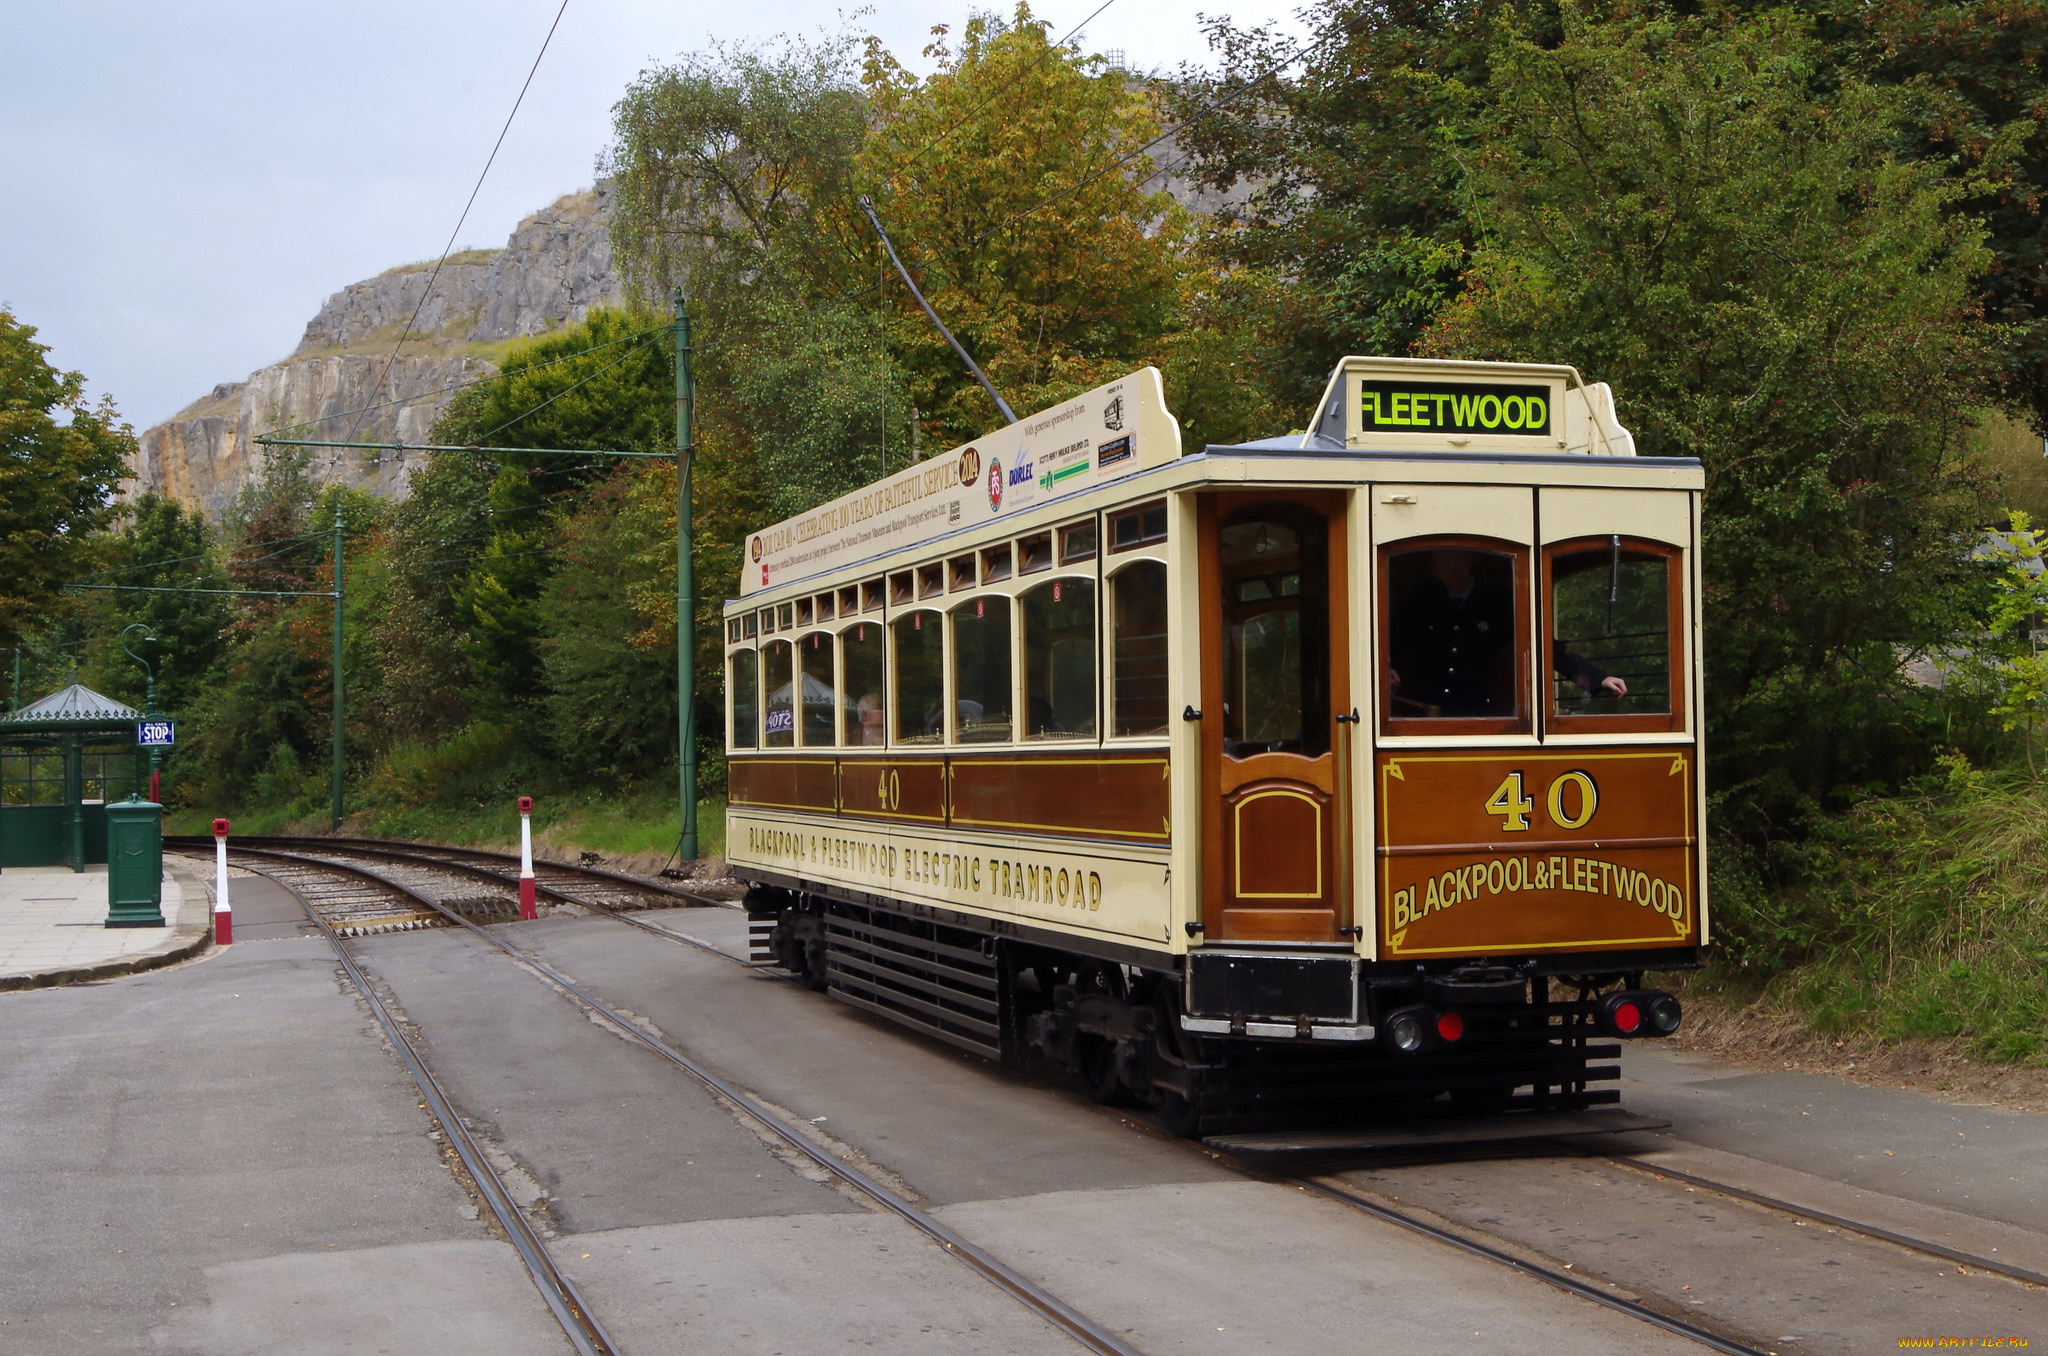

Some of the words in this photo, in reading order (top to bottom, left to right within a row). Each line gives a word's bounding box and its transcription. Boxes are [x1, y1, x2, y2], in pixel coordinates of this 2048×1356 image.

[1024, 424, 1034, 436] With
[1035, 420, 1050, 437] generous
[1051, 406, 1074, 429] sponsorship
[1075, 404, 1086, 416] from
[1362, 391, 1547, 429] FLEETWOOD
[961, 451, 978, 482] 2014
[1009, 462, 1033, 486] DORLEC
[796, 508, 838, 544] CELEBRATING
[839, 505, 849, 529] 100
[848, 494, 874, 524] YEARS
[874, 490, 882, 515] OF
[884, 474, 922, 512] FAITHFUL
[924, 460, 958, 497] SERVICE
[892, 518, 907, 534] Blackpool
[908, 513, 923, 528] Transport
[924, 506, 938, 520] Services
[144, 726, 169, 740] STOP
[878, 768, 900, 811] 40
[1484, 769, 1598, 832] 40
[750, 826, 806, 862] BLACKPOOL
[810, 836, 817, 863] &
[822, 836, 898, 877] FLEETWOOD
[904, 848, 981, 892] ELECTRIC
[989, 858, 1102, 912] TRAMROAD
